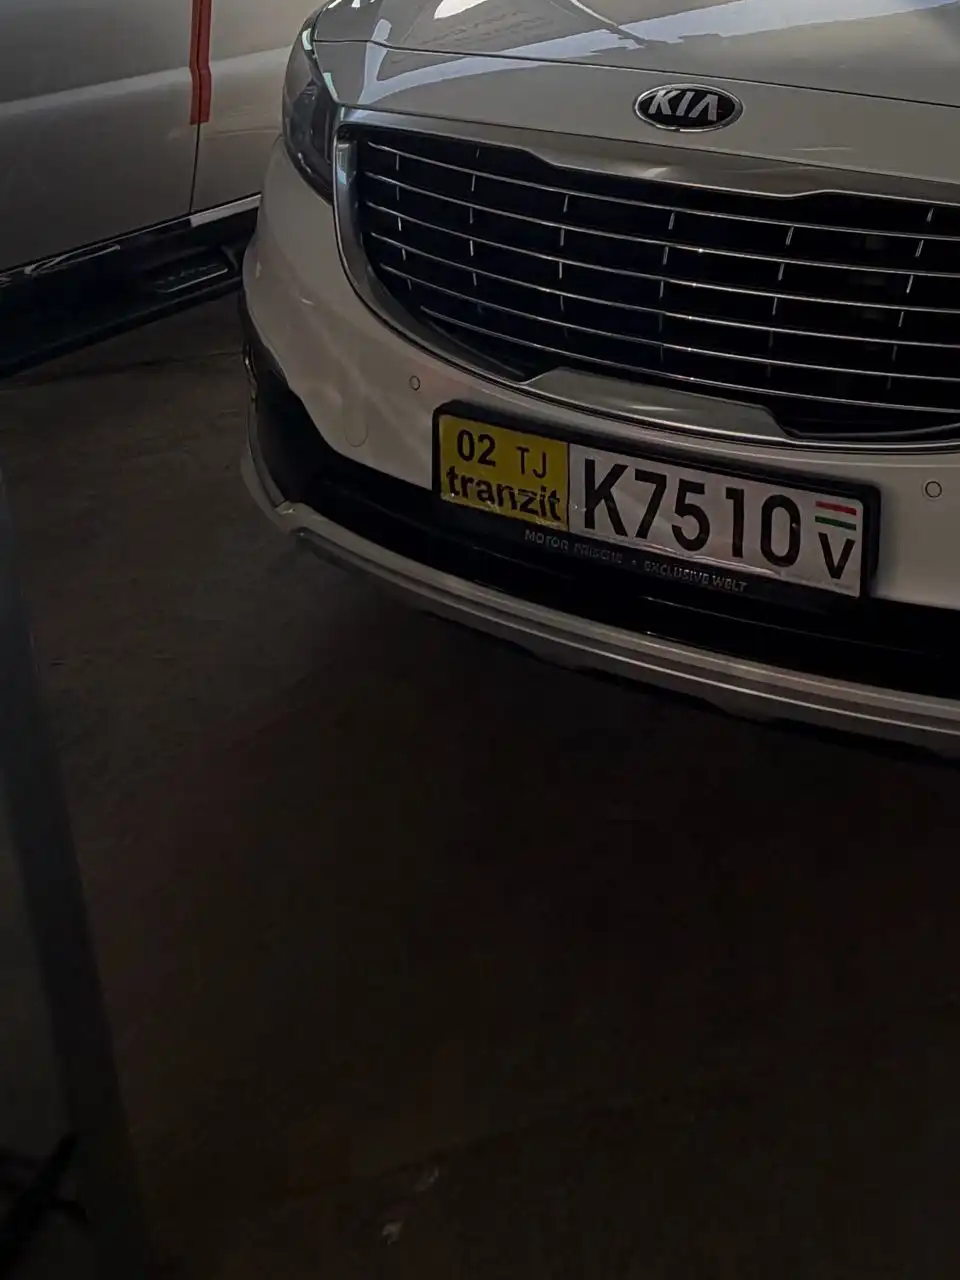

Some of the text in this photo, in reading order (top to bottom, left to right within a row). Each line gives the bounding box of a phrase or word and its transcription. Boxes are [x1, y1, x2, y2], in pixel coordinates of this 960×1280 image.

[648, 89, 719, 121] KIA
[456, 429, 548, 479] 02 TJ
[446, 465, 561, 522] tranzit
[584, 458, 802, 568] K7510
[643, 560, 710, 586] EXCLUSIVE
[817, 531, 856, 580] V
